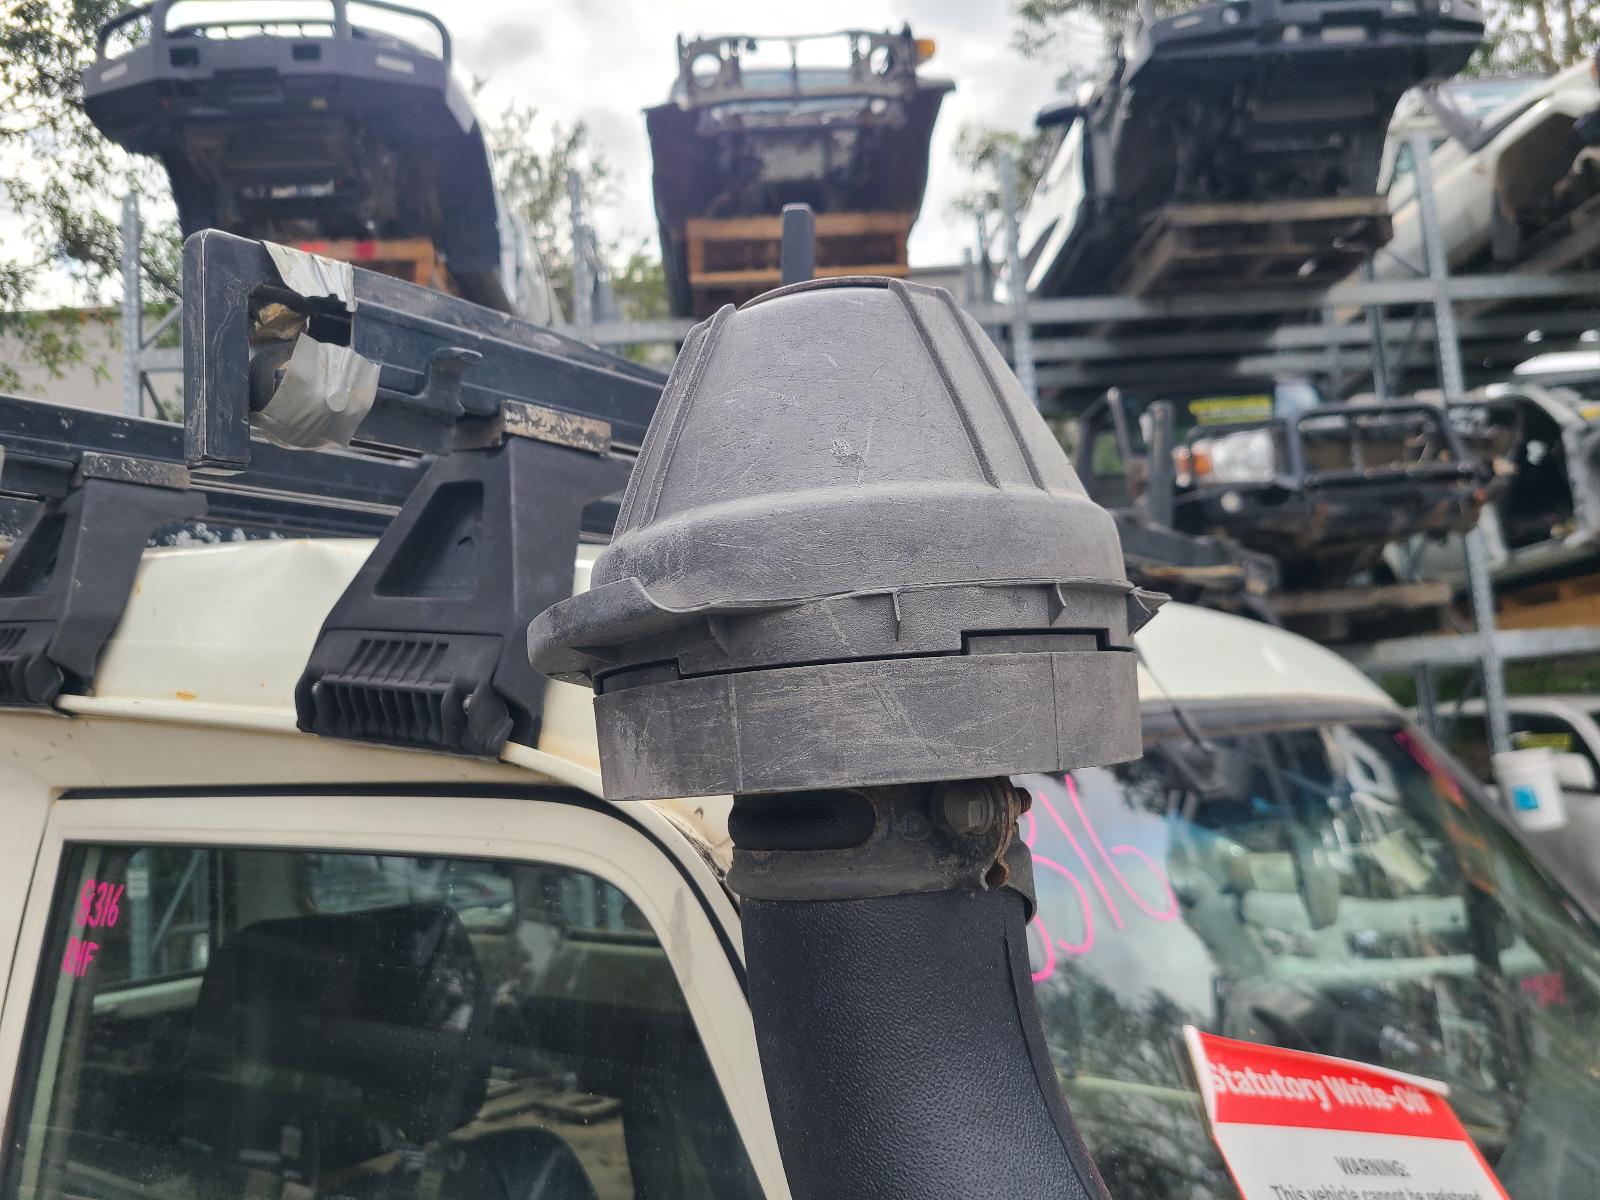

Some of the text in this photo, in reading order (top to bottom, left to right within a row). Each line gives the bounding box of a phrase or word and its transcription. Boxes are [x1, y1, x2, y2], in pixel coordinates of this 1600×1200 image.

[1028, 773, 1179, 983] 316
[76, 879, 124, 928] 8316
[1209, 1062, 1331, 1112] Statutory
[1269, 1184, 1305, 1200] This
[1306, 1184, 1359, 1200] vehicle
